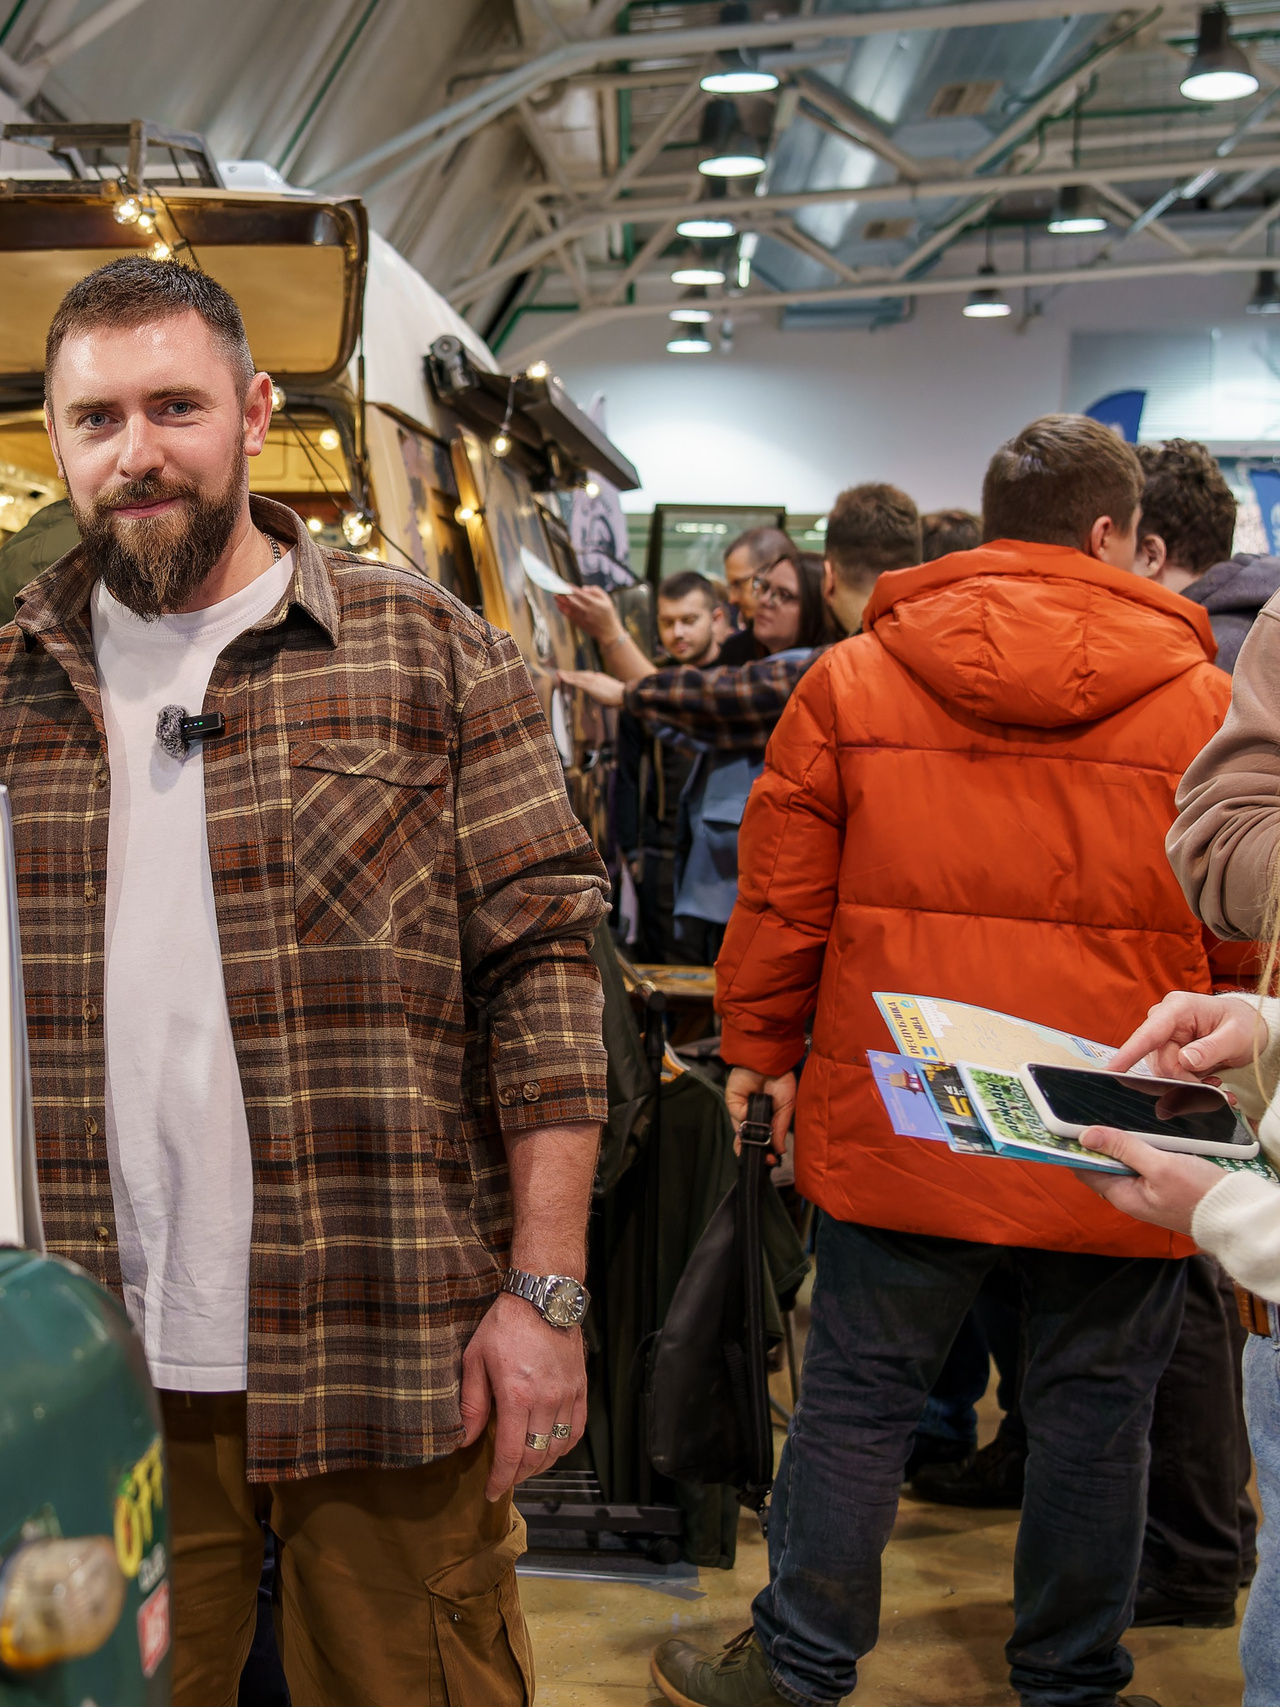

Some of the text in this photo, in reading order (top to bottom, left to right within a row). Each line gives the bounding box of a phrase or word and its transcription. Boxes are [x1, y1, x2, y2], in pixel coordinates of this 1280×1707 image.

[887, 1001, 920, 1055] РЕСПУБЛИКА
[910, 1016, 928, 1040] ТЫВА
[987, 1082, 1021, 1132] АРЖААН
